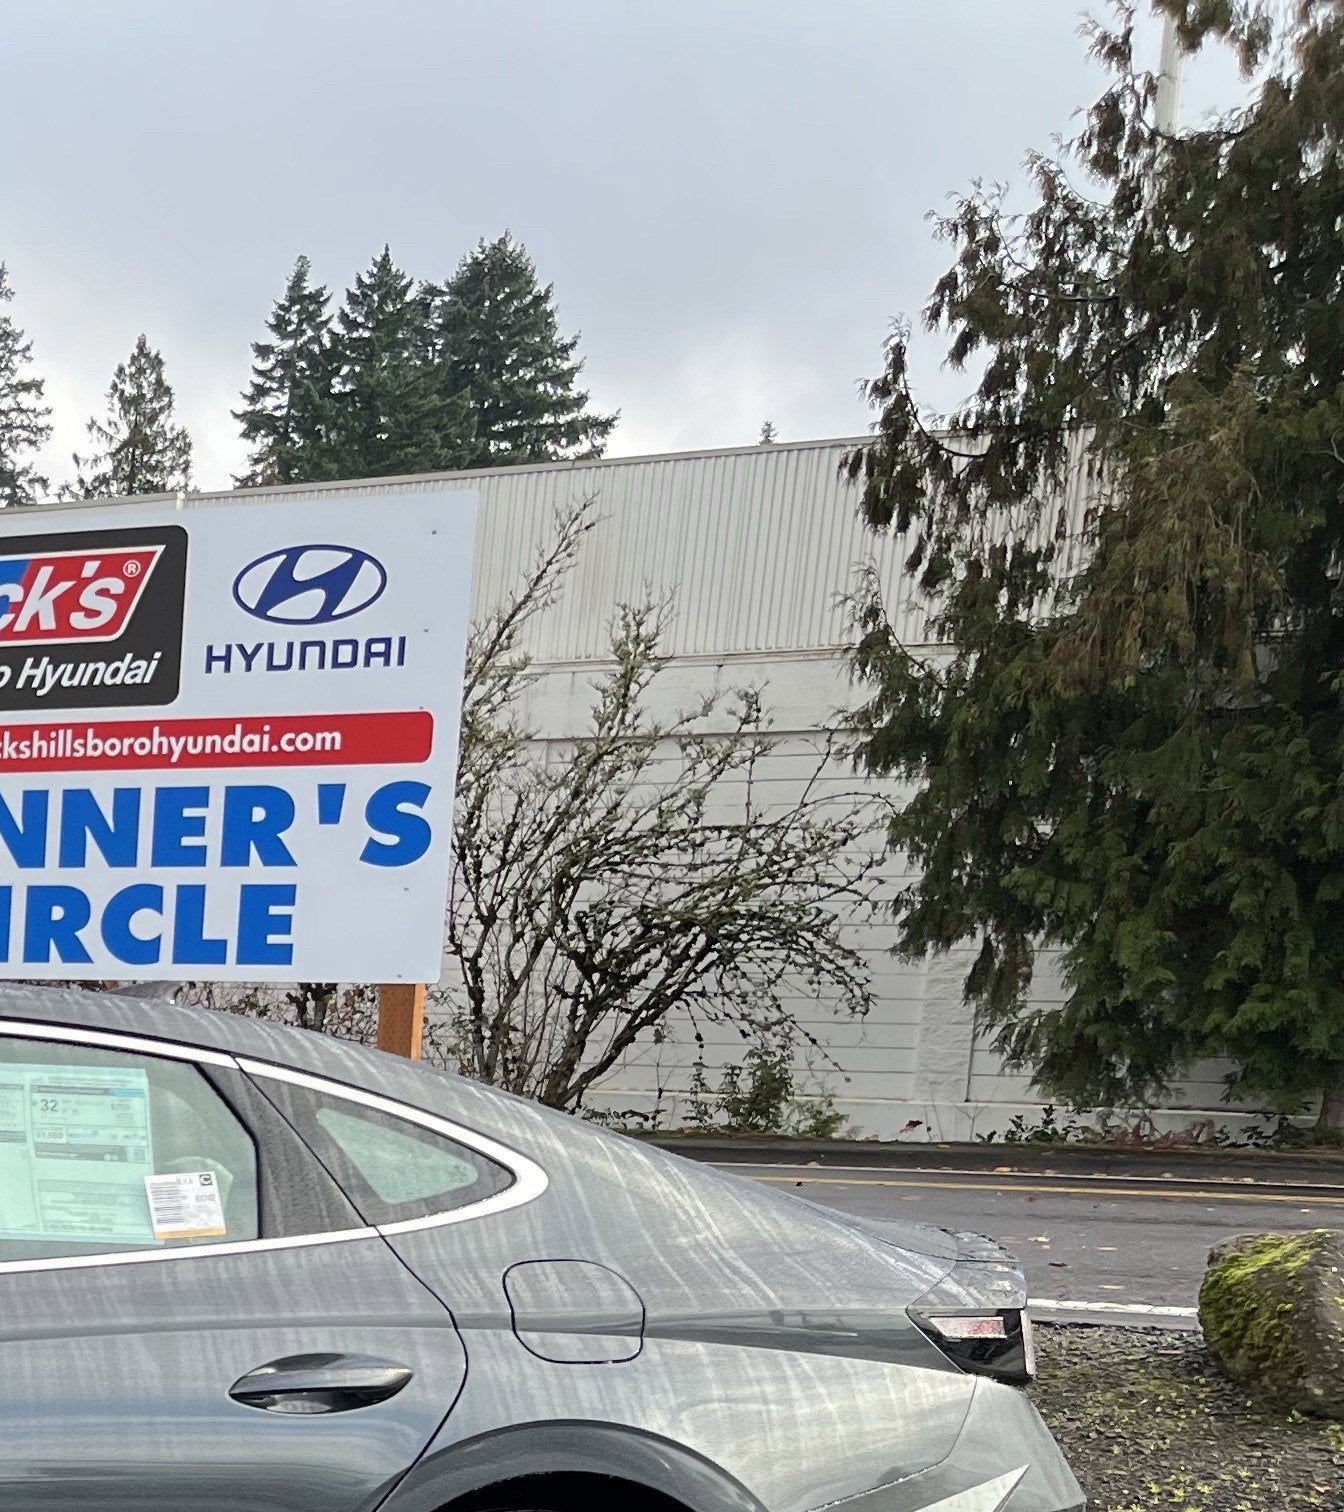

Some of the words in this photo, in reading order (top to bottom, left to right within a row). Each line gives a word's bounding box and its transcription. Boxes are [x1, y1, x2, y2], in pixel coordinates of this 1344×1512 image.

[15, 651, 162, 697] Hyundai
[205, 636, 407, 674] HYUNDAI
[40, 1099, 58, 1112] 32
